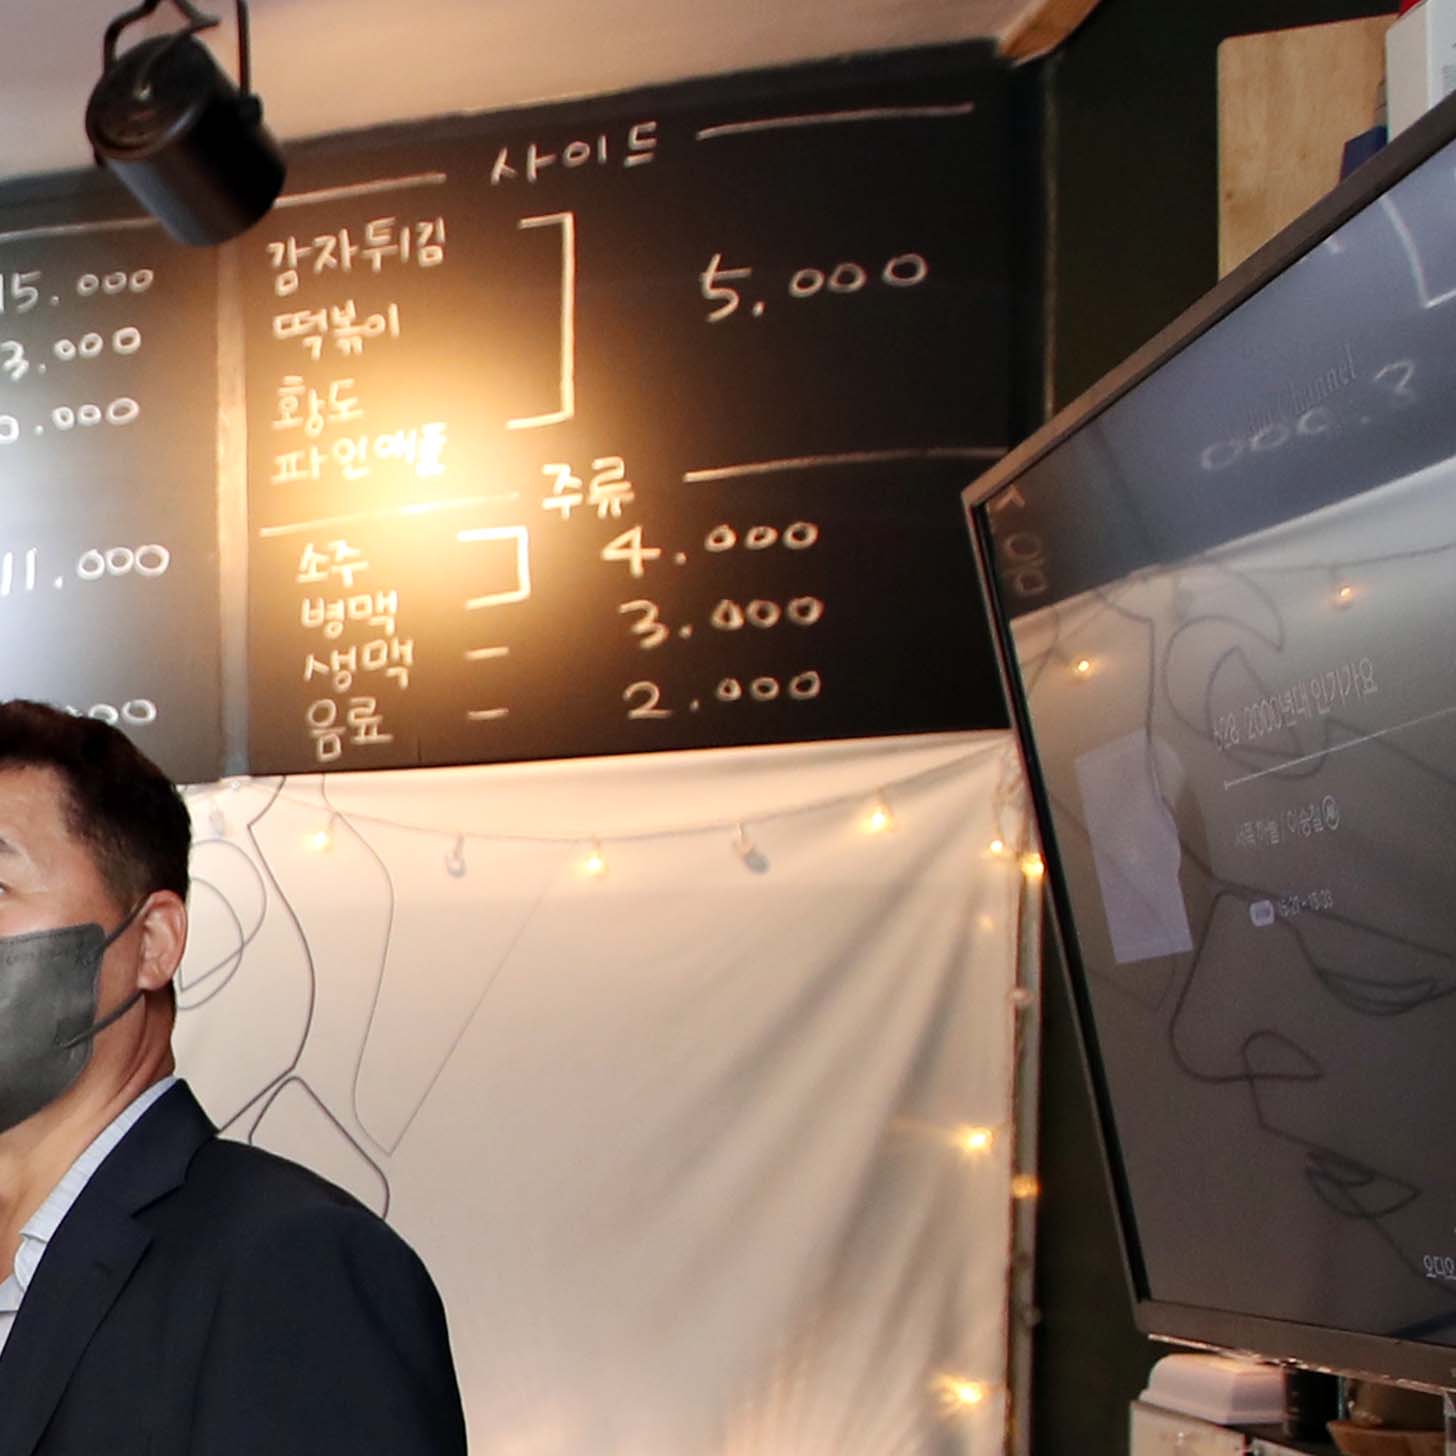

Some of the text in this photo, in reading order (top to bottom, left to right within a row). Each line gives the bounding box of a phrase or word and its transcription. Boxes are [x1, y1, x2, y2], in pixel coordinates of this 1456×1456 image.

[490, 122, 658, 186] 사이드
[267, 216, 446, 296] 감자튀김
[699, 253, 927, 322] 5.000
[272, 301, 400, 360] 떡볶이
[272, 376, 363, 434] 황도
[272, 421, 448, 485] 파인애플
[540, 458, 634, 518] 주류
[0, 543, 170, 597] 11.000
[298, 540, 368, 586] 소주
[602, 522, 818, 576] 4.000
[301, 589, 399, 639] 병맥
[619, 598, 823, 648] 3.000
[304, 637, 413, 687] 생맥
[623, 673, 821, 721] 2.000
[305, 695, 392, 760] 음료
